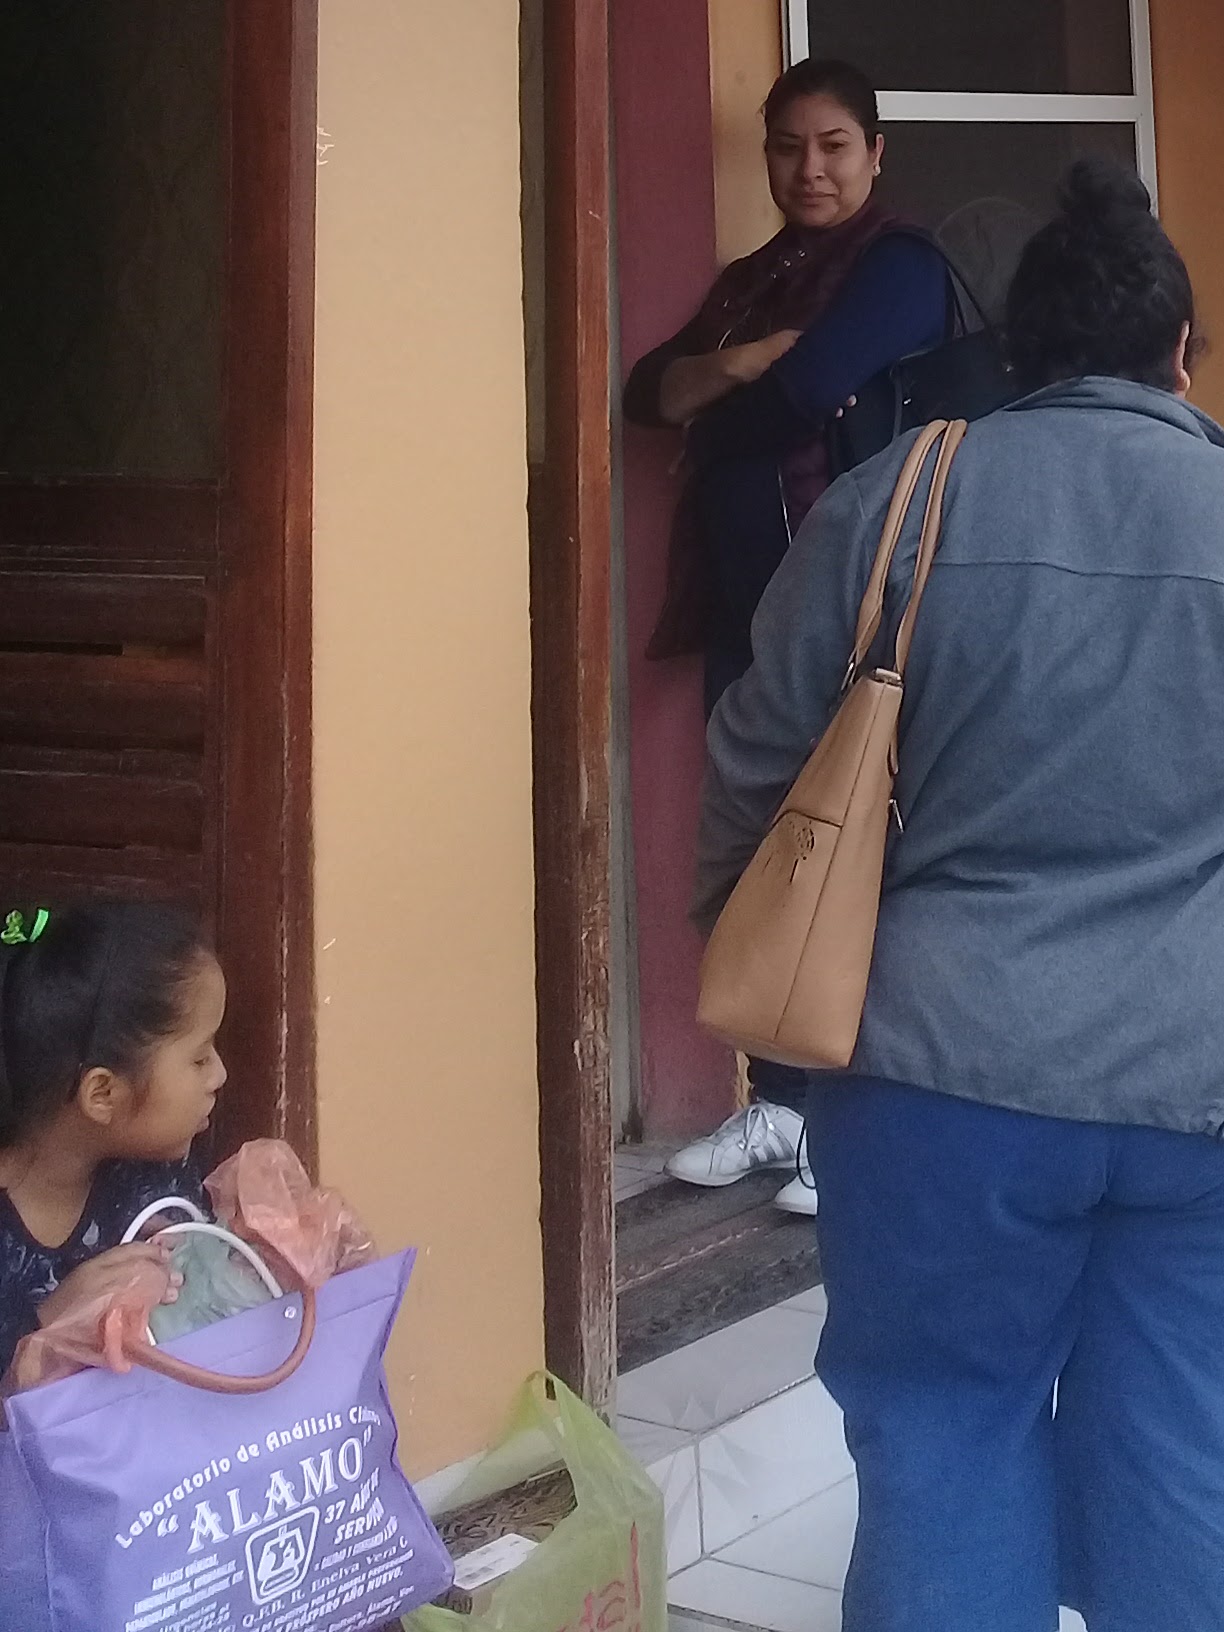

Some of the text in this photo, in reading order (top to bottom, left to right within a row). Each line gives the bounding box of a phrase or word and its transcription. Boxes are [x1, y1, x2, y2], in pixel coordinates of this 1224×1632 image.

[115, 1457, 231, 1549] Laboratorio
[236, 1444, 260, 1463] de
[266, 1411, 342, 1453] Análisis
[325, 1500, 346, 1524] 37
